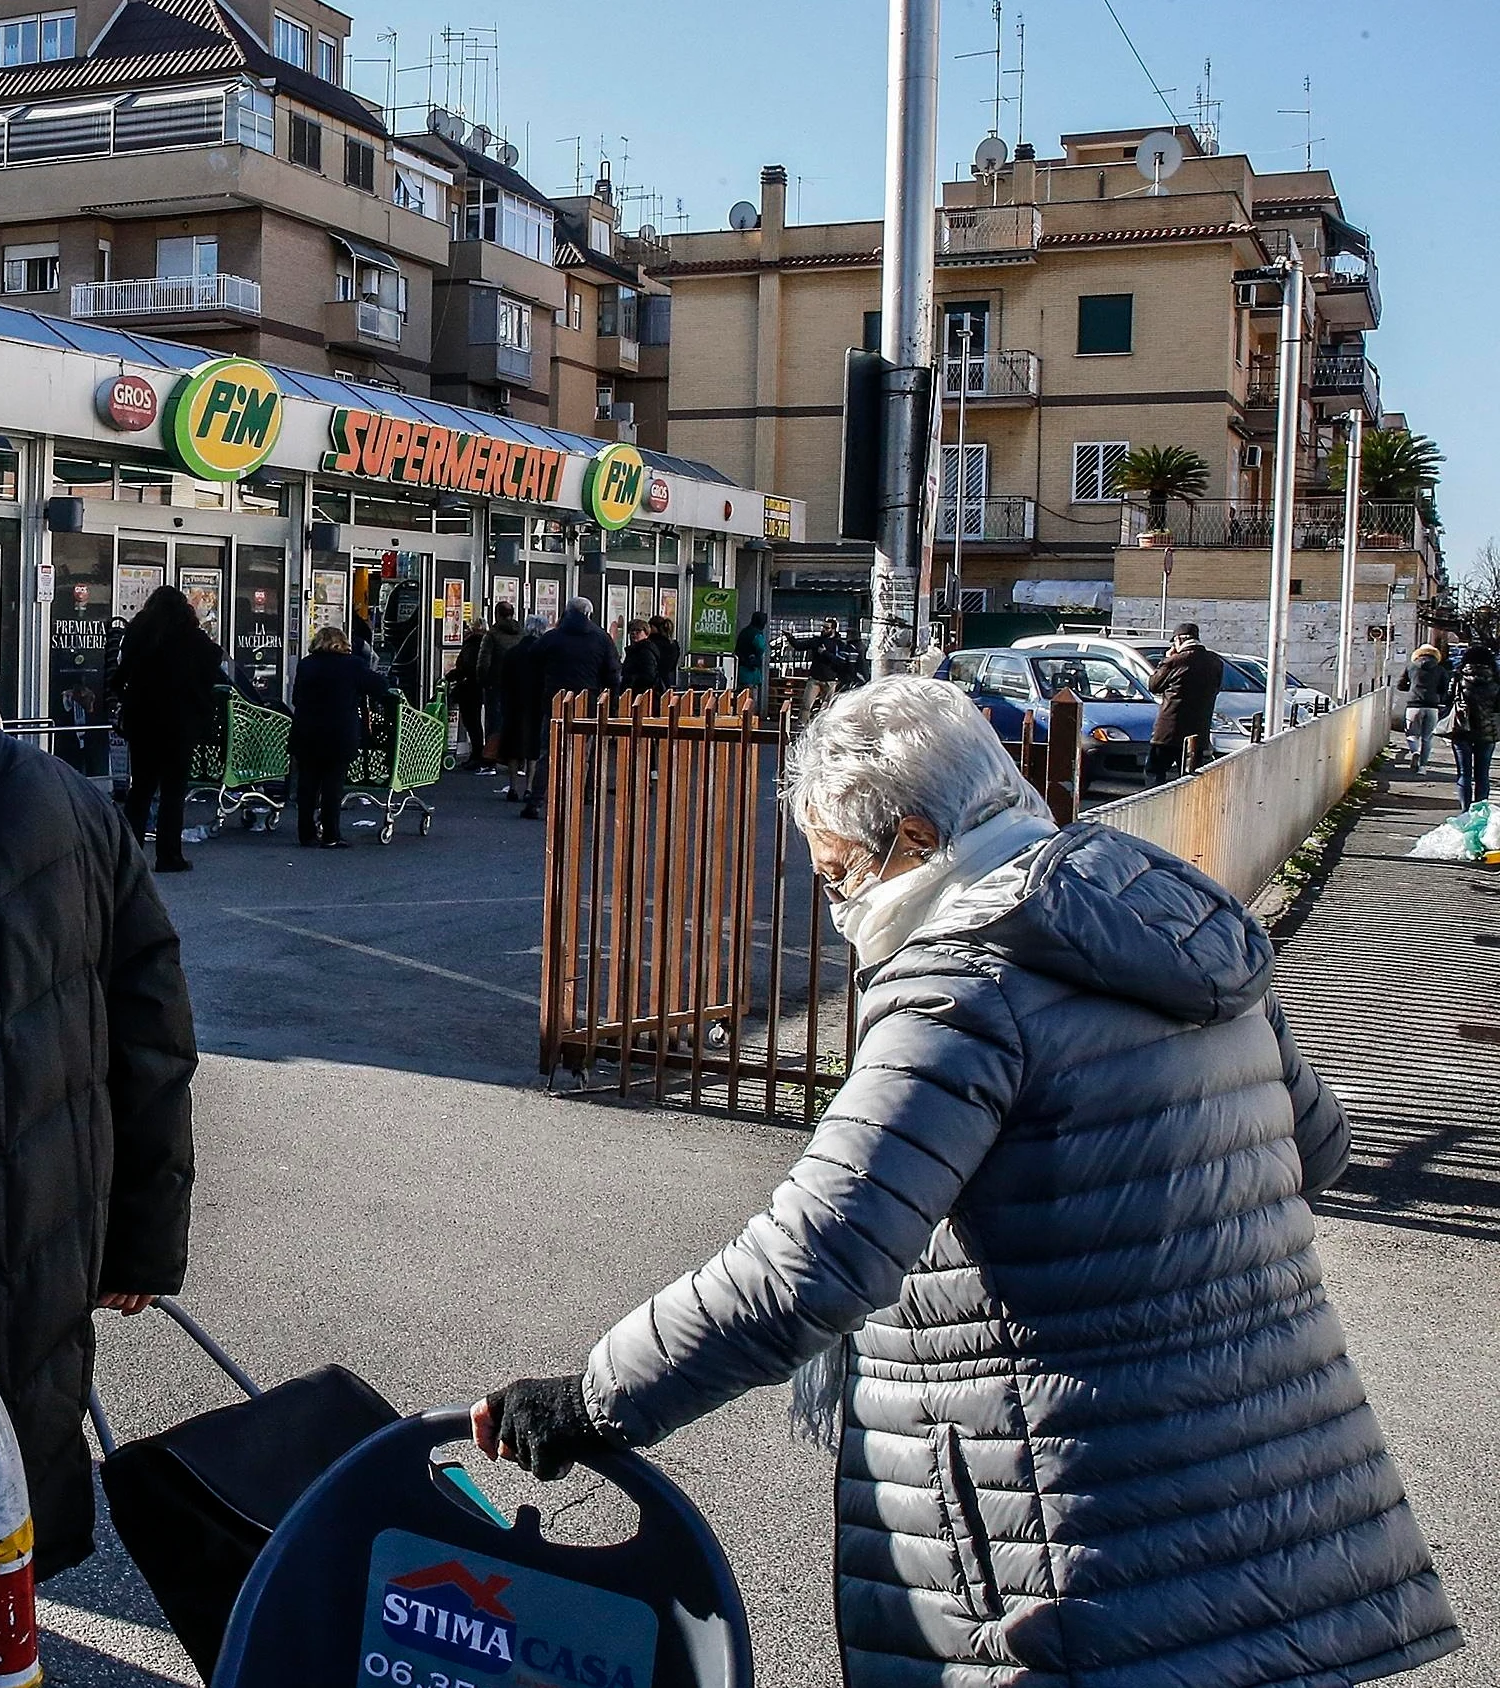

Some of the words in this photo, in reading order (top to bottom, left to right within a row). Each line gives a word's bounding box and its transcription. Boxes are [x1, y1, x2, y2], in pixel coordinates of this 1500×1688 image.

[113, 383, 152, 409] GROS
[325, 408, 568, 503] SUPERMERCATI
[651, 484, 668, 499] GROS
[700, 608, 728, 624] AREA
[56, 620, 107, 635] PREMIATA
[256, 622, 266, 635] LA
[694, 621, 732, 635] CARRELLI
[238, 635, 282, 648] MACELLERIA
[382, 1593, 513, 1662] STIMA
[520, 1637, 636, 1688] CASA
